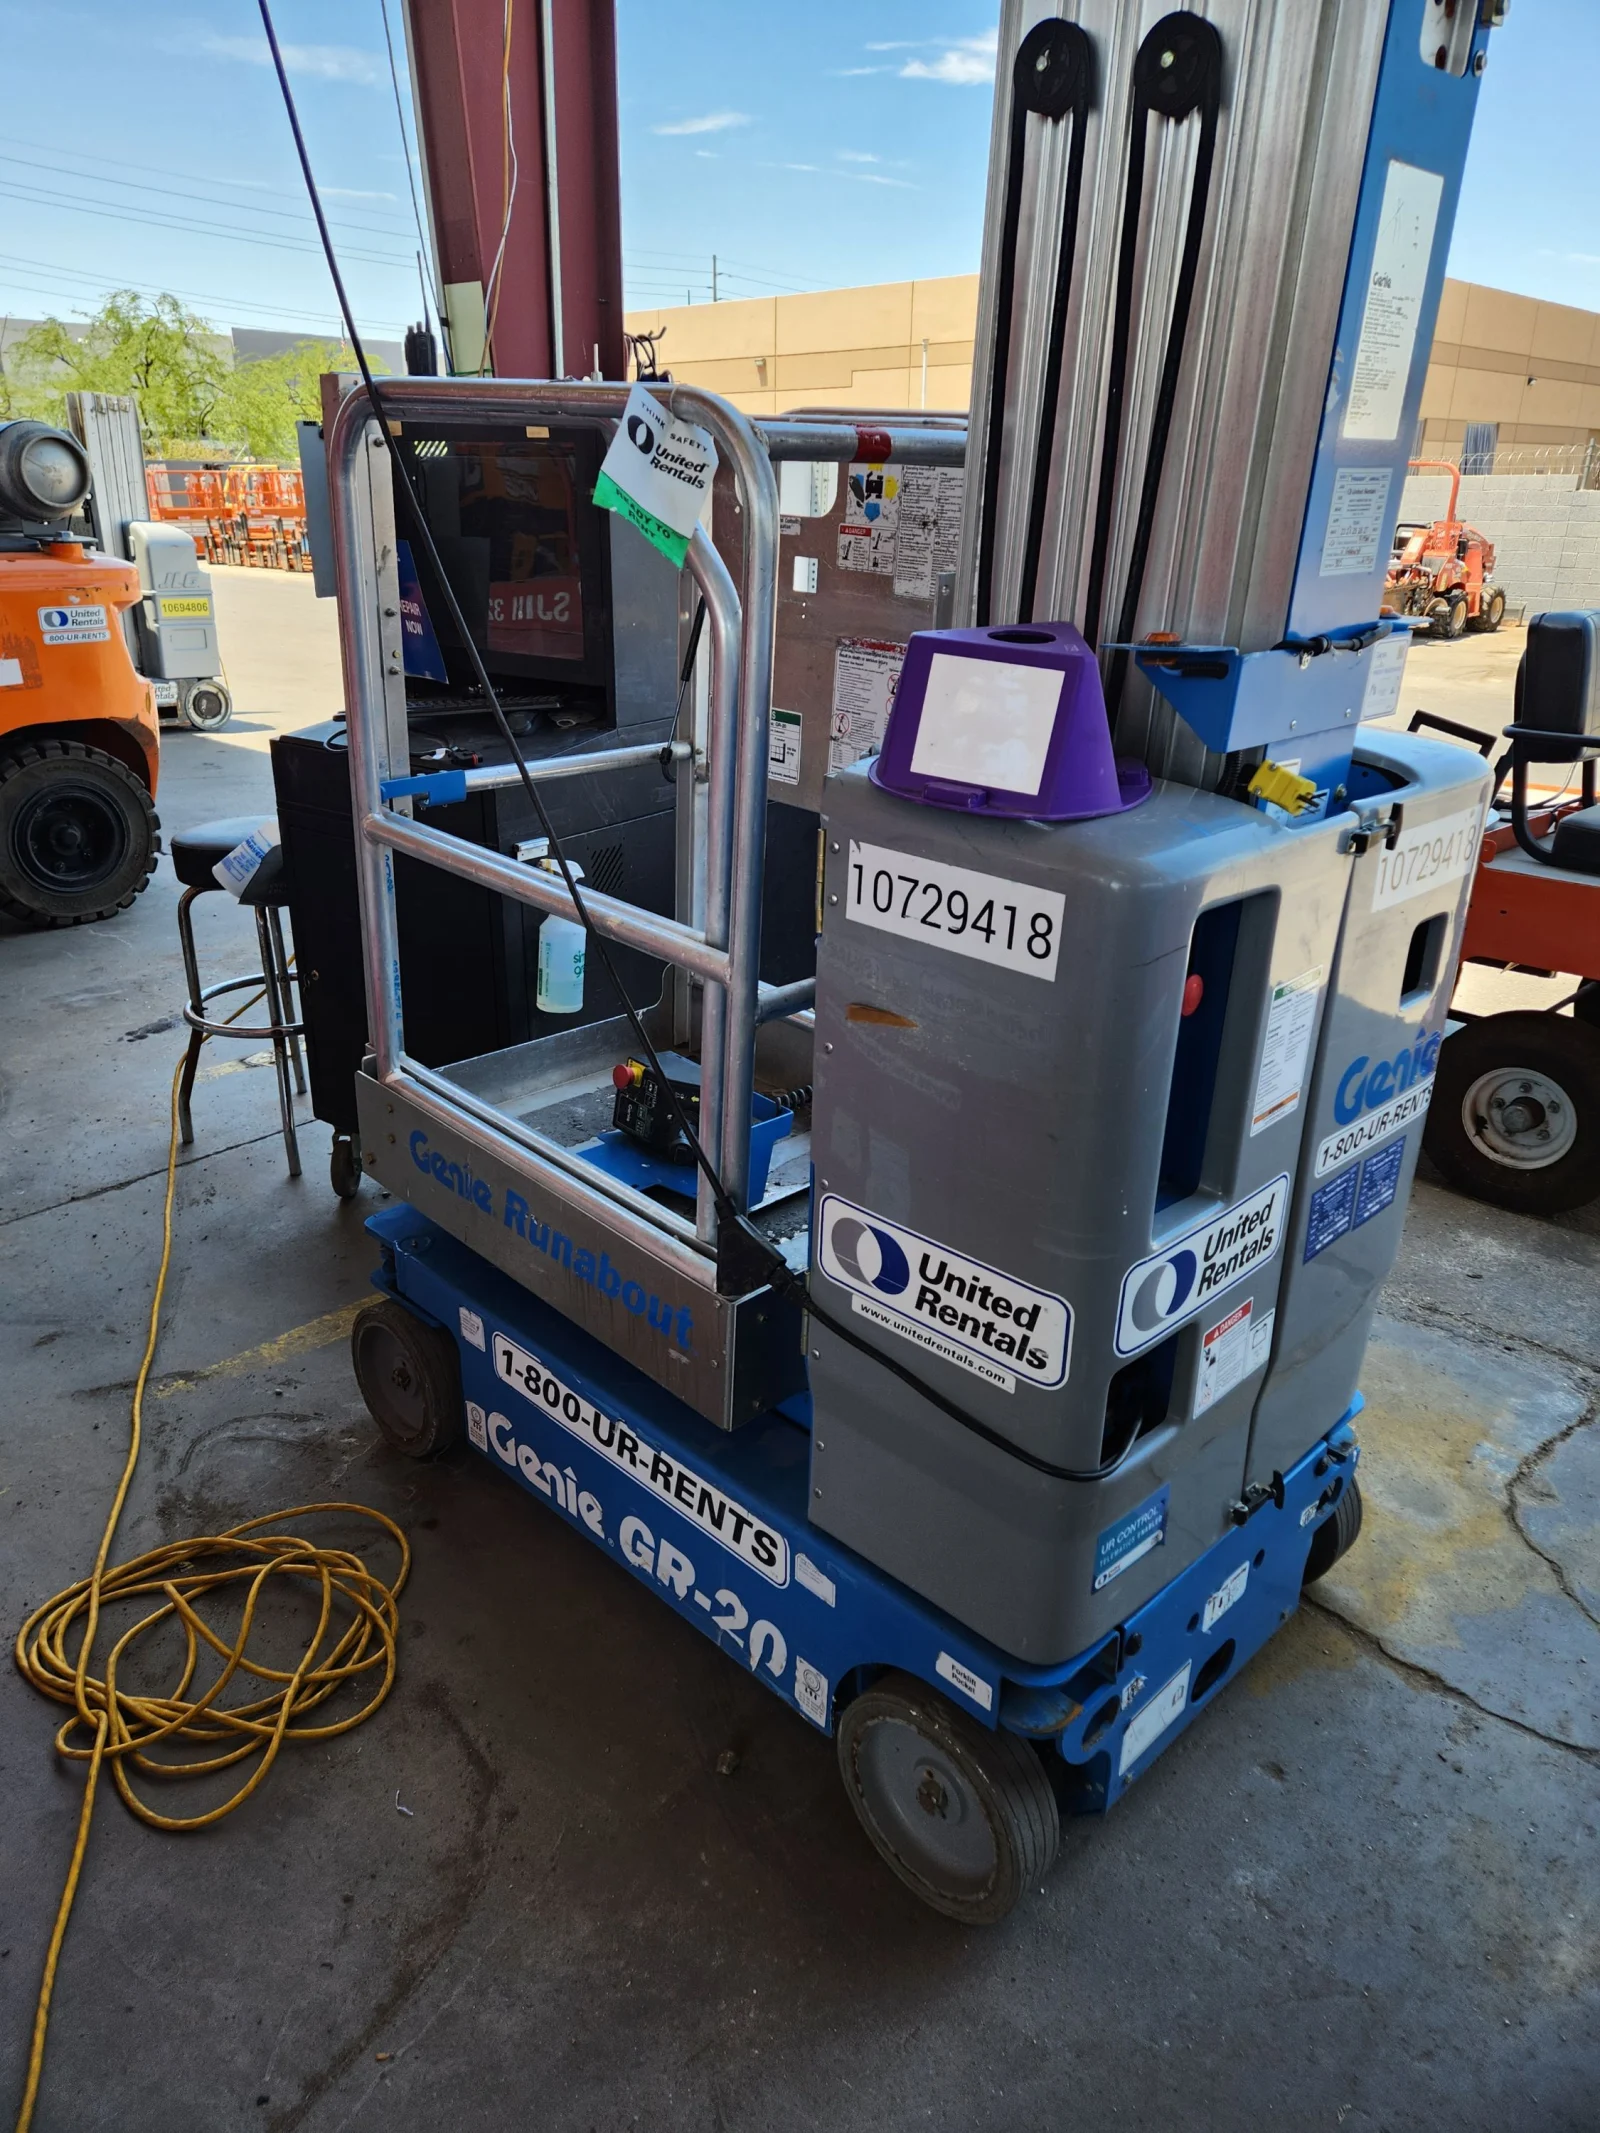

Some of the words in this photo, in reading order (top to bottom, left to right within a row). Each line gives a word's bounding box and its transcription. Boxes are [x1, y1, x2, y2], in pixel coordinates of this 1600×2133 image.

[641, 401, 667, 428] THINK
[655, 444, 707, 474] United
[670, 433, 708, 453] SAFETY
[650, 457, 706, 490] Rentals
[615, 487, 652, 525] READY
[656, 522, 671, 539] TO
[158, 571, 198, 589] JLG
[70, 608, 101, 618] United
[71, 617, 105, 627] Rentals
[162, 601, 208, 613] 10694806
[49, 631, 107, 642] 800-UR-RENTS
[405, 619, 423, 635] NOW
[1379, 824, 1478, 896] 10729418
[853, 864, 1054, 960] 10729418
[1334, 1026, 1441, 1126] Genie
[1322, 1081, 1435, 1168] 1-800-UR-RENTS
[409, 1129, 493, 1217] Genie
[504, 1188, 694, 1350] Runabout
[1203, 1192, 1276, 1263] United
[1197, 1226, 1275, 1298] Rentals
[918, 1252, 1042, 1333] United
[914, 1284, 1049, 1371] Rentals
[1220, 1309, 1243, 1334] DANGER
[860, 1303, 1006, 1385] www.unitedrentals.com
[501, 1349, 779, 1568] 1-800-UR-RENTS
[487, 1411, 605, 1540] Genie
[619, 1515, 788, 1678] GR-20
[1101, 1537, 1116, 1555] UR
[1116, 1505, 1159, 1544] CONTROL
[952, 1663, 977, 1689] Forklift
[952, 1672, 976, 1695] Pocket
